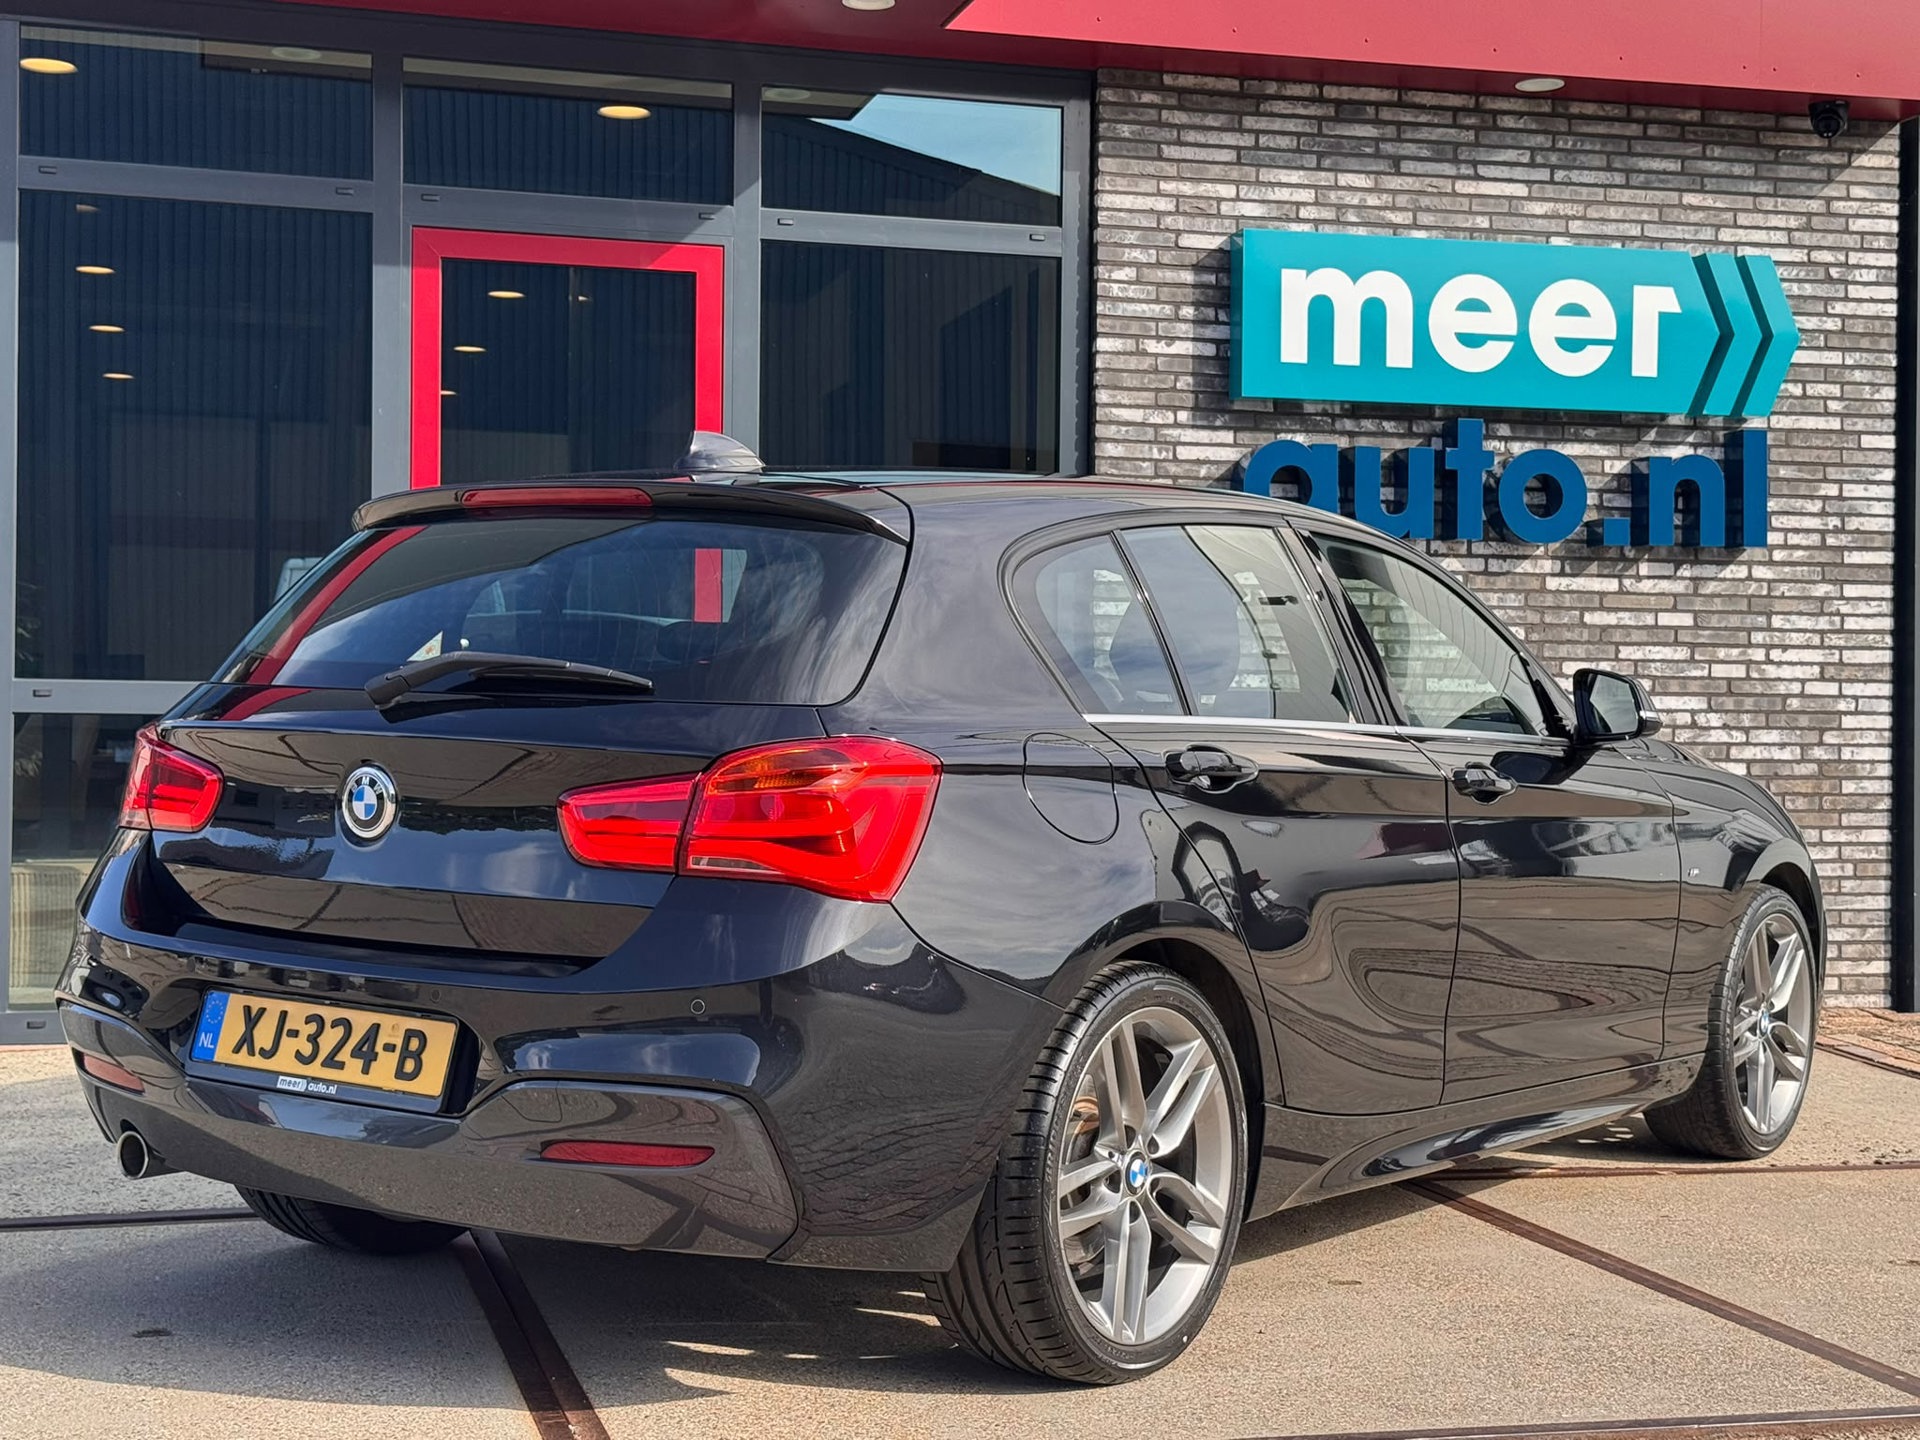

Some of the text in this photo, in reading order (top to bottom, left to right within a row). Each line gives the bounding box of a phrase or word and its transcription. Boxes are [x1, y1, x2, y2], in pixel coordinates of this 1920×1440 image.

[1280, 266, 1682, 378] meer
[1243, 418, 1768, 548] auto.nl
[199, 1031, 215, 1049] NL
[231, 1004, 428, 1082] XJ-324-B
[279, 1078, 338, 1095] meer auto.nl
